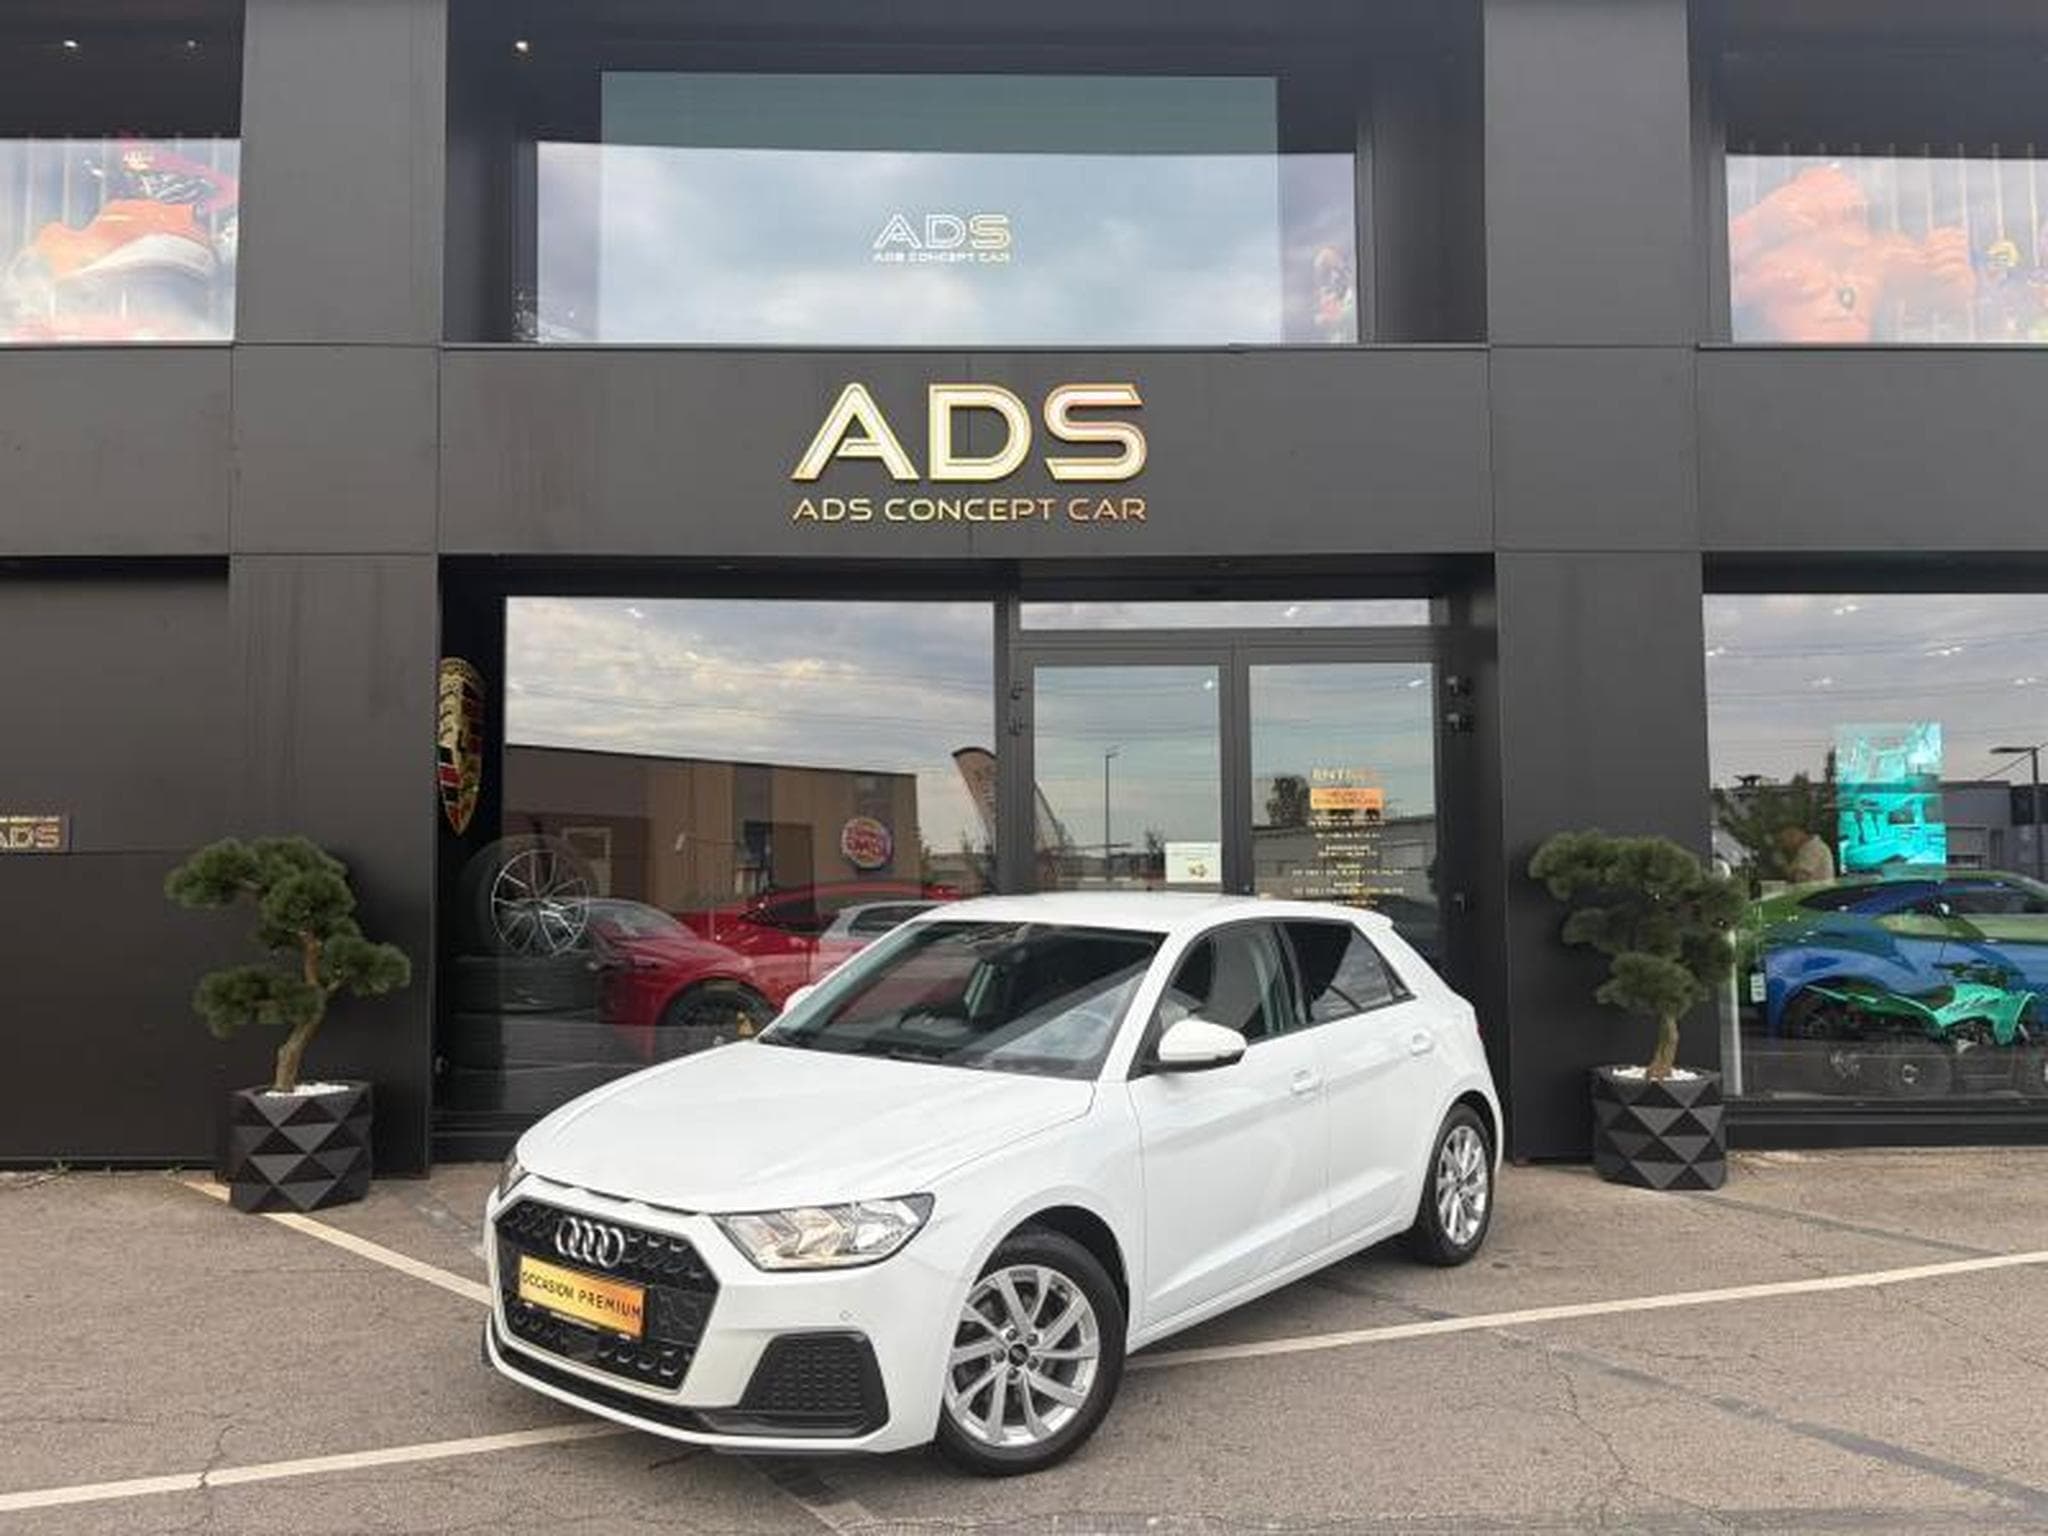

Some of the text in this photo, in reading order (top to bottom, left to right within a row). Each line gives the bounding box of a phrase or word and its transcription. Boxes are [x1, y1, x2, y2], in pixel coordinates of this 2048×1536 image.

[872, 213, 1012, 250] ADS
[790, 381, 1148, 482] ADS
[791, 497, 1148, 522] ADS CONCEPT CAR
[577, 1289, 641, 1319] PREMIUM
